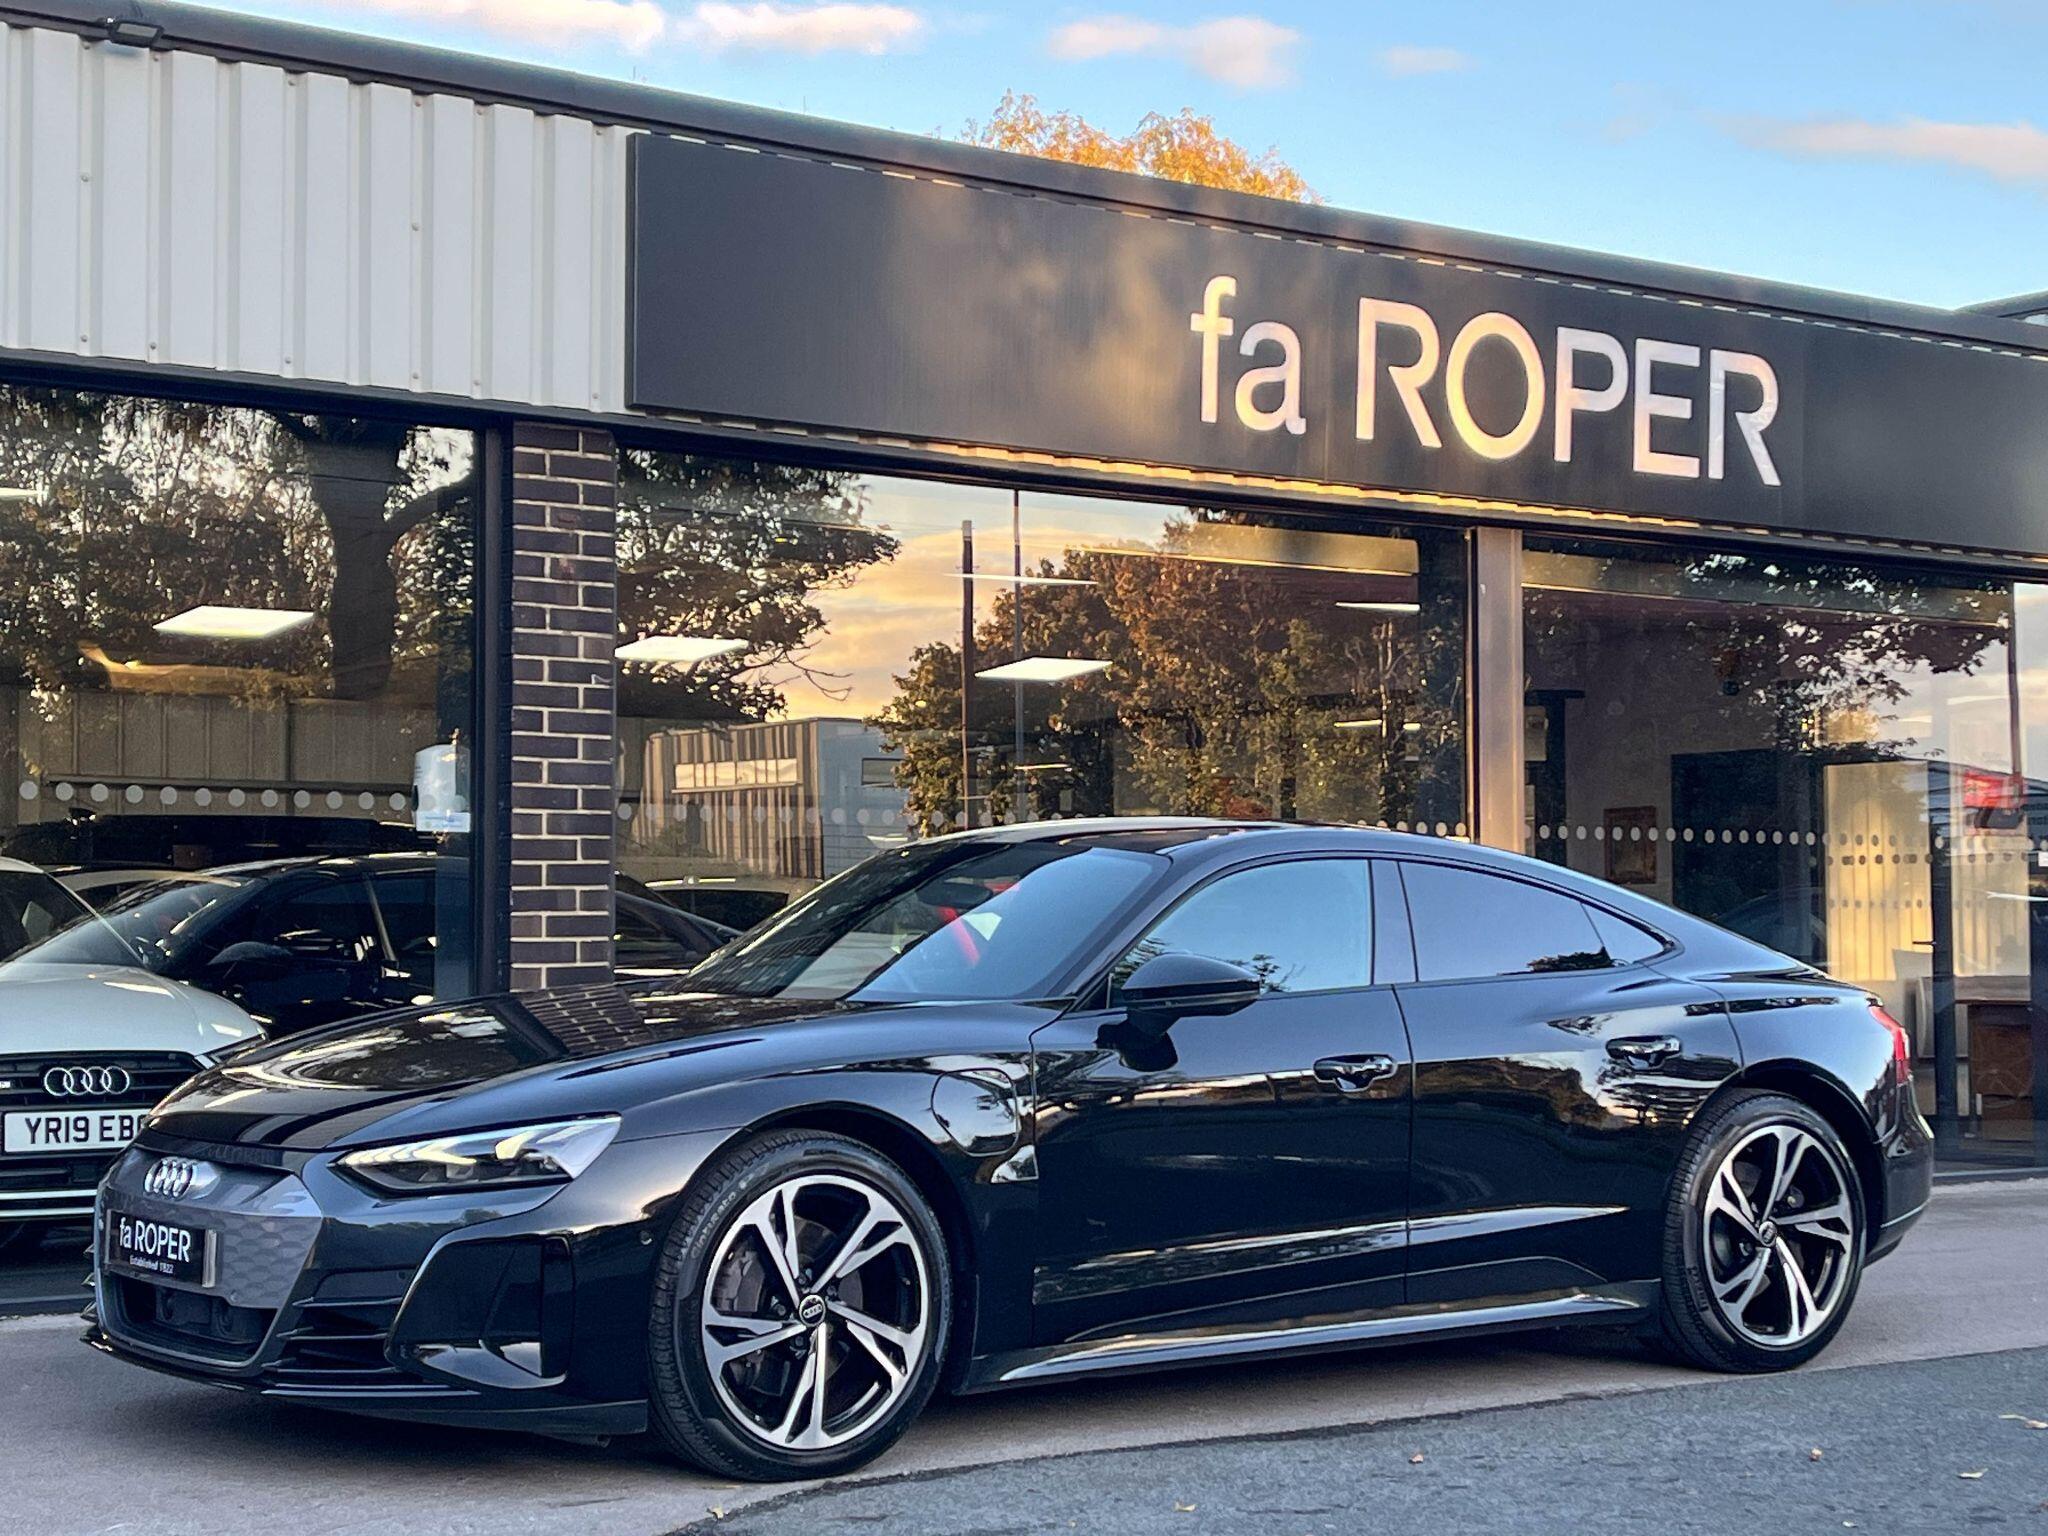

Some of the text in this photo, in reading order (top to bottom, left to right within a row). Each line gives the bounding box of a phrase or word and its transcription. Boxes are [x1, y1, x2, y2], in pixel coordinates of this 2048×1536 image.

[1190, 276, 1782, 487] fa ROPER
[24, 1116, 90, 1144] YR19
[119, 1217, 191, 1263] fa ROPER
